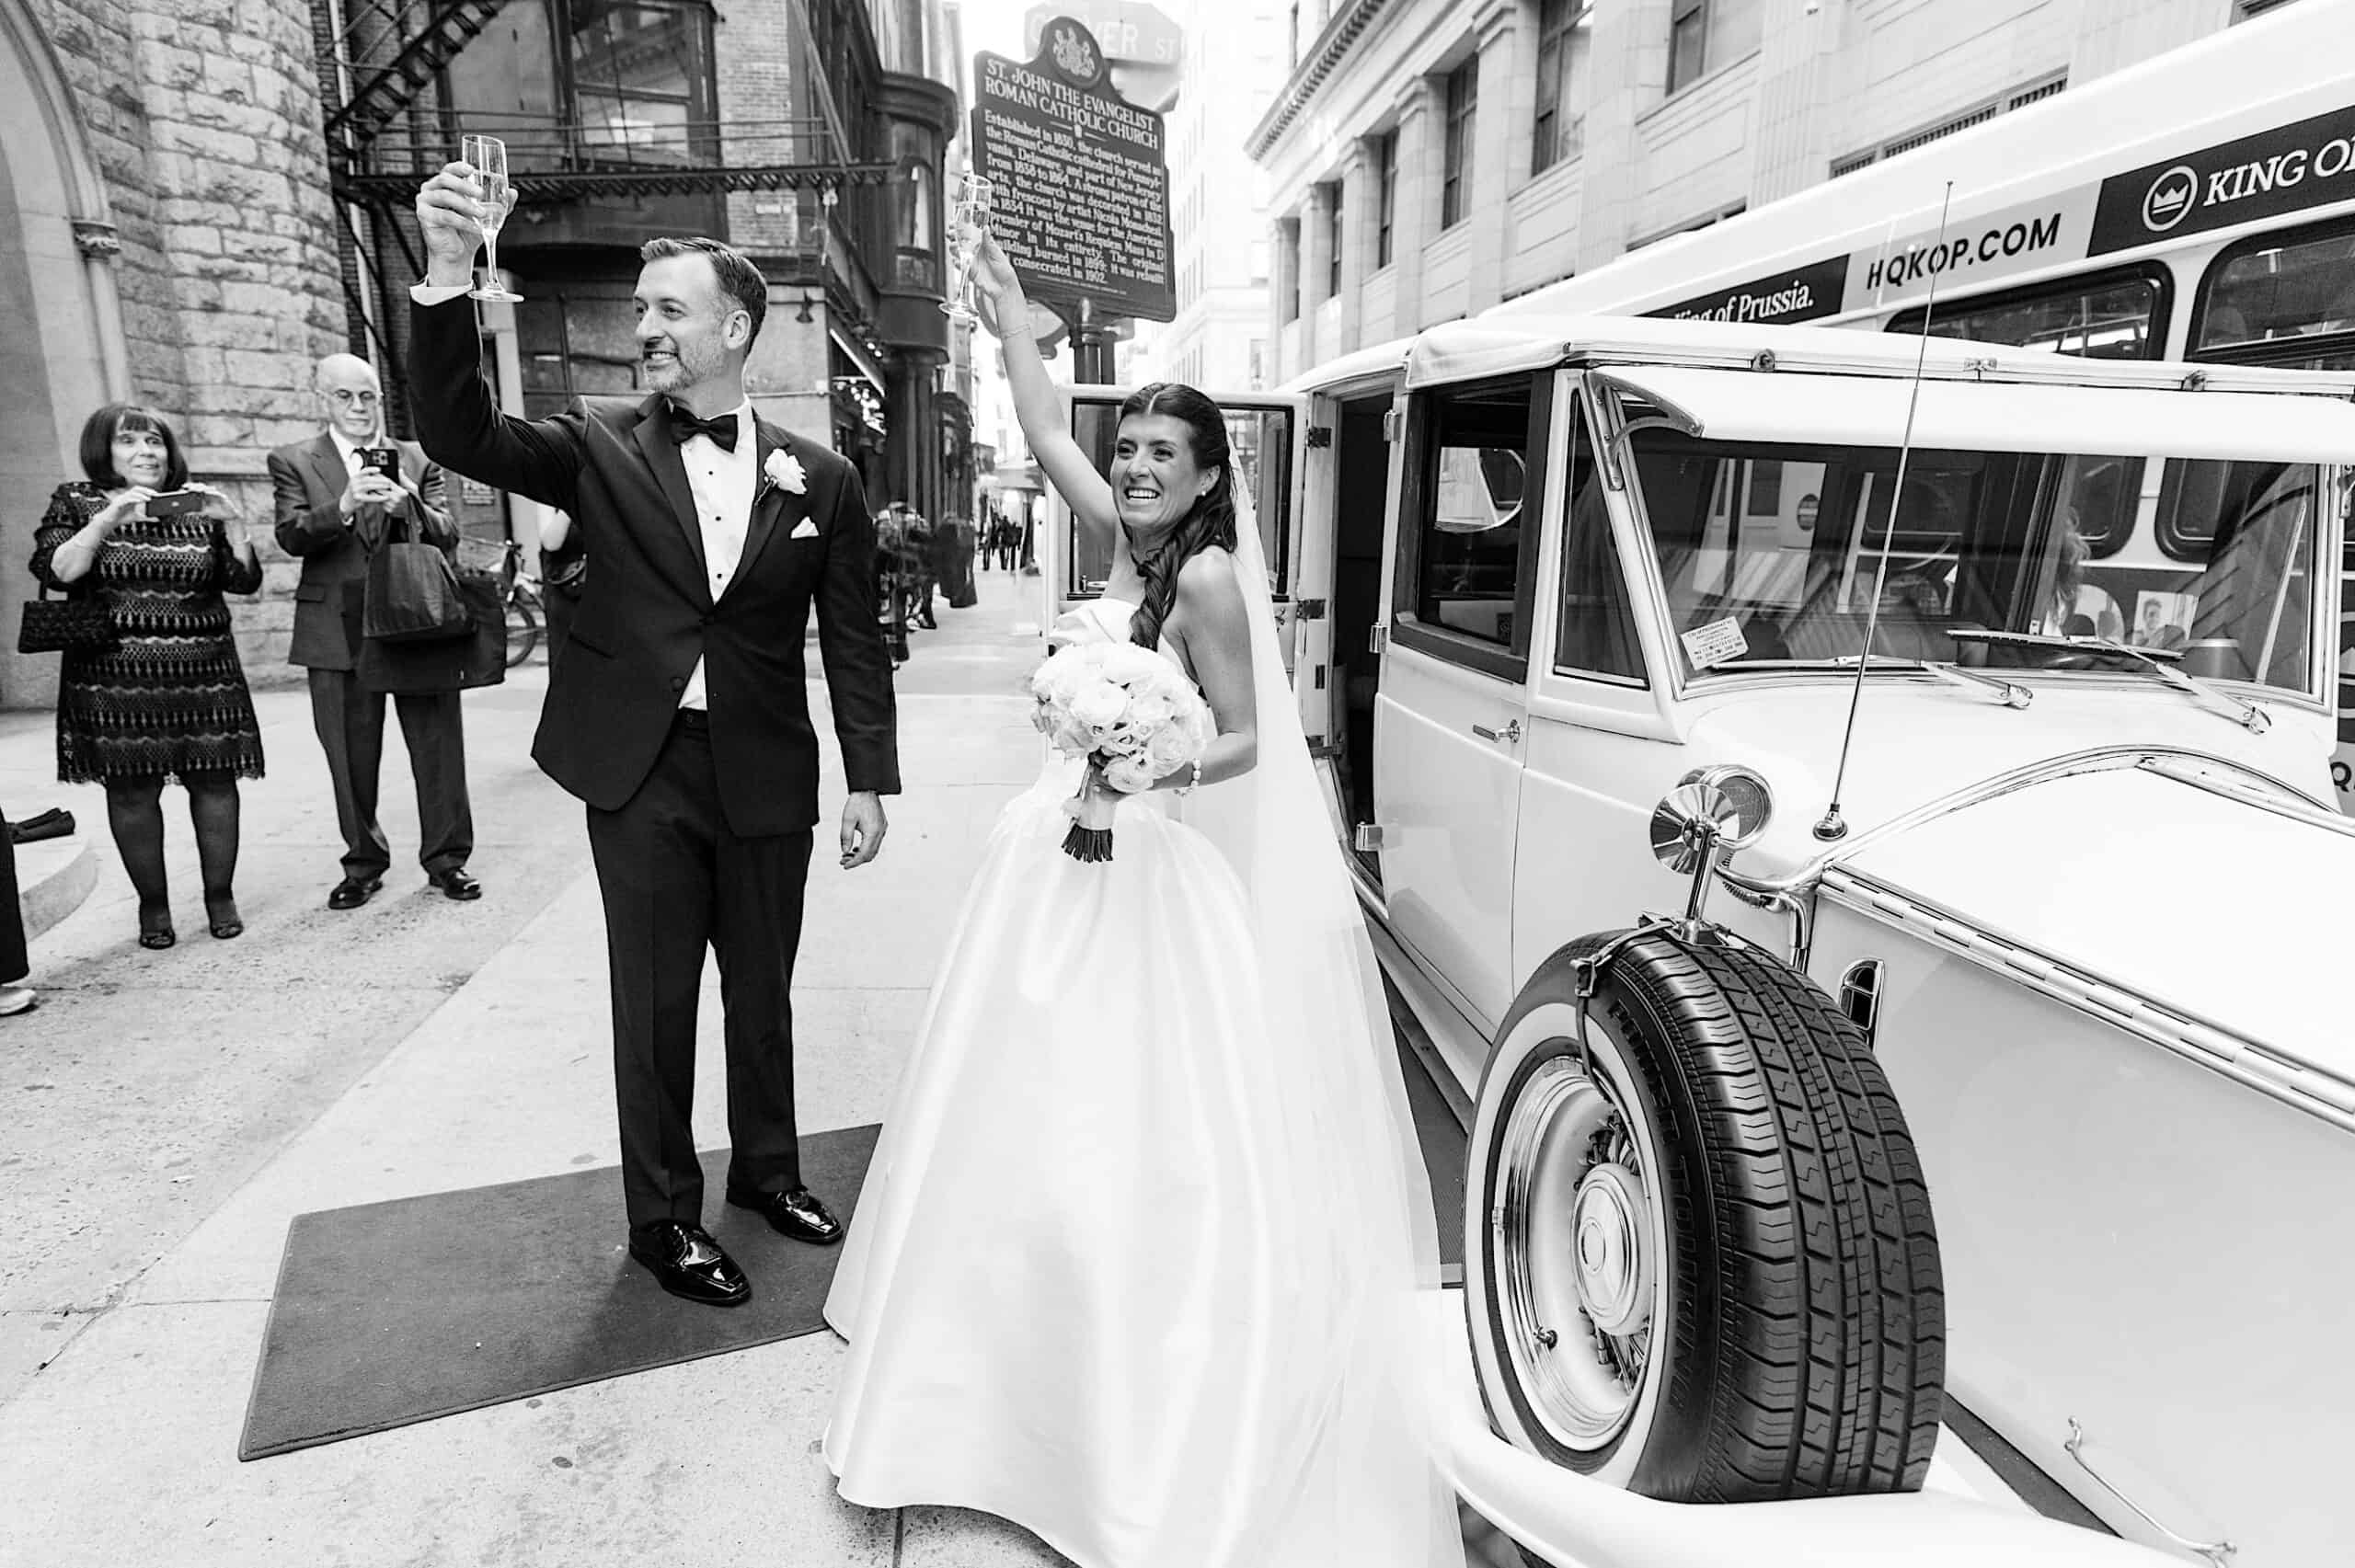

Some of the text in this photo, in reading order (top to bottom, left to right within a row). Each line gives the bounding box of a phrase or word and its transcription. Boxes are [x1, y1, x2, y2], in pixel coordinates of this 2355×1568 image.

[986, 59, 1155, 131] ST. JOHN THE EVANGELIST
[986, 76, 1157, 150] ROMAN CATHOLIC CHURCH
[985, 110, 1040, 138] Established
[1042, 130, 1052, 143] in
[1077, 141, 1092, 155] the
[1094, 147, 1123, 165] church
[1125, 158, 1151, 173] served
[1153, 166, 1162, 176] as
[986, 126, 1161, 189] the Roman Catholic cathedral for Pennsyl-
[986, 142, 1162, 201] vania, Delaware, and part of New Jersey
[987, 153, 1012, 171] from
[1015, 160, 1036, 177] 1838
[1038, 168, 1048, 180] to
[1074, 179, 1082, 189] A
[1083, 183, 1110, 200] strong
[1112, 190, 1139, 206] patron
[1140, 198, 1148, 208] of
[1150, 200, 1162, 212] the
[987, 170, 1012, 185] arts,
[1016, 176, 1031, 189] the
[1034, 182, 1067, 199] church
[1069, 191, 1085, 203] was
[1087, 196, 1131, 216] decorated
[1133, 209, 1142, 219] in
[2203, 149, 2309, 207] KING
[992, 198, 1163, 248] n 1834 it was the venue for the American
[1012, 188, 1051, 207] frescoes
[1053, 198, 1065, 212] by
[1066, 204, 1091, 218] artist
[1093, 209, 1120, 225] Nicola
[1028, 232, 1037, 244] in
[1046, 235, 1059, 248] its
[1064, 243, 1103, 259] entirety.
[1109, 250, 1127, 264] The
[1132, 258, 1164, 273] original
[1031, 220, 1042, 232] of
[1046, 222, 1084, 241] Mozart's
[1086, 232, 1122, 251] Requiem
[1124, 241, 1144, 257] Mass
[1146, 247, 1155, 258] in
[1156, 249, 1164, 260] D
[1035, 246, 1070, 263] burned
[1073, 255, 1082, 267] in
[1110, 263, 1119, 274] it
[1120, 267, 1134, 278] was
[1136, 270, 1164, 284] rebuilt
[1867, 212, 2062, 292] HQKOP.COM
[1014, 258, 1071, 276] consecrated
[1074, 268, 1083, 280] in
[1738, 280, 1813, 322] Prussia.
